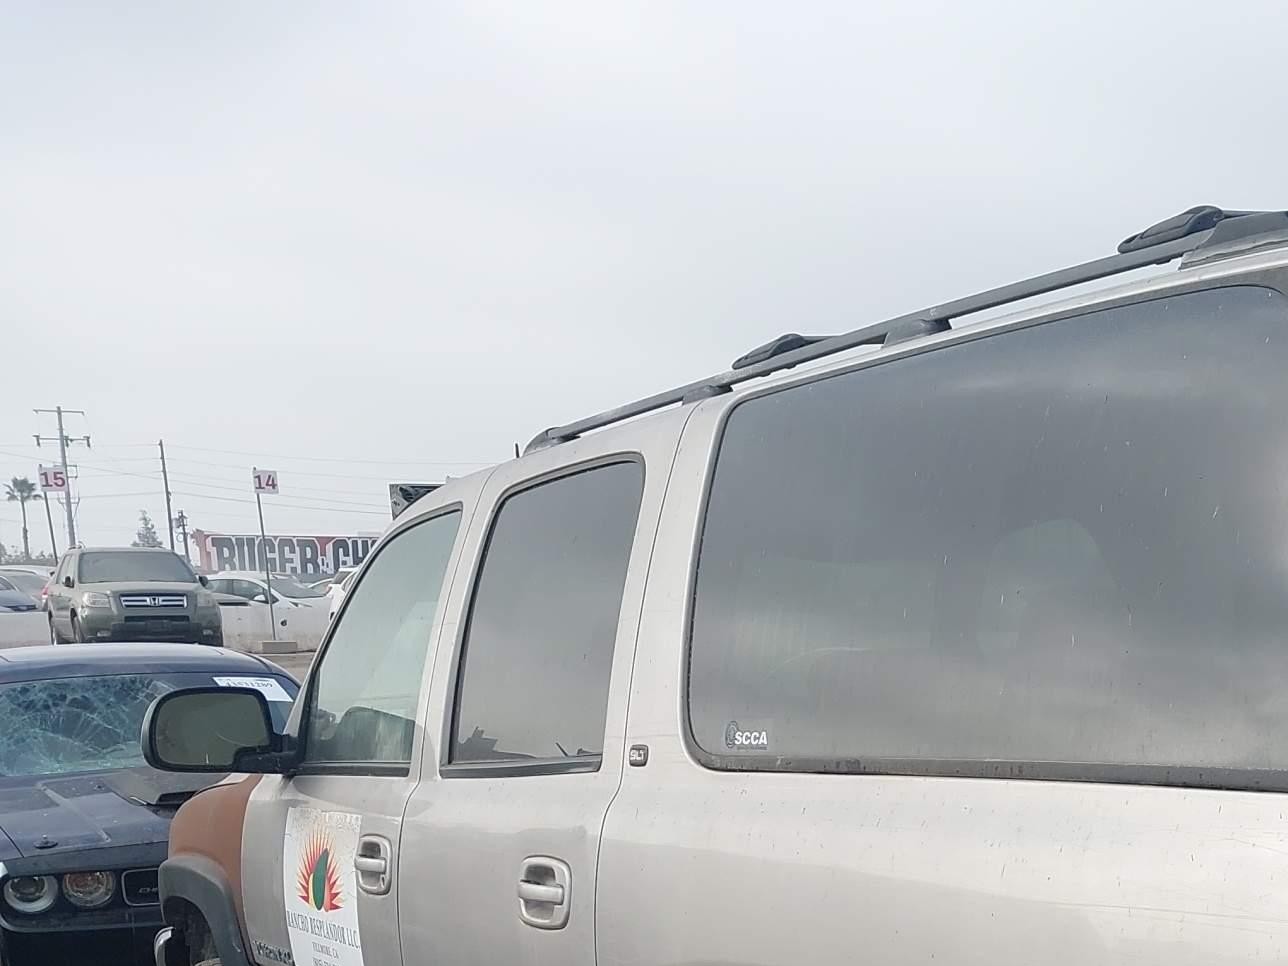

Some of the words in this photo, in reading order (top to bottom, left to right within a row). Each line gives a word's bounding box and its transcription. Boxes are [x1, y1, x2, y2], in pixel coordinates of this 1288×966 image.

[41, 471, 66, 488] 15
[254, 474, 278, 490] 14
[327, 536, 377, 572] CH
[734, 731, 768, 745] SCCA
[630, 749, 645, 761] SLT
